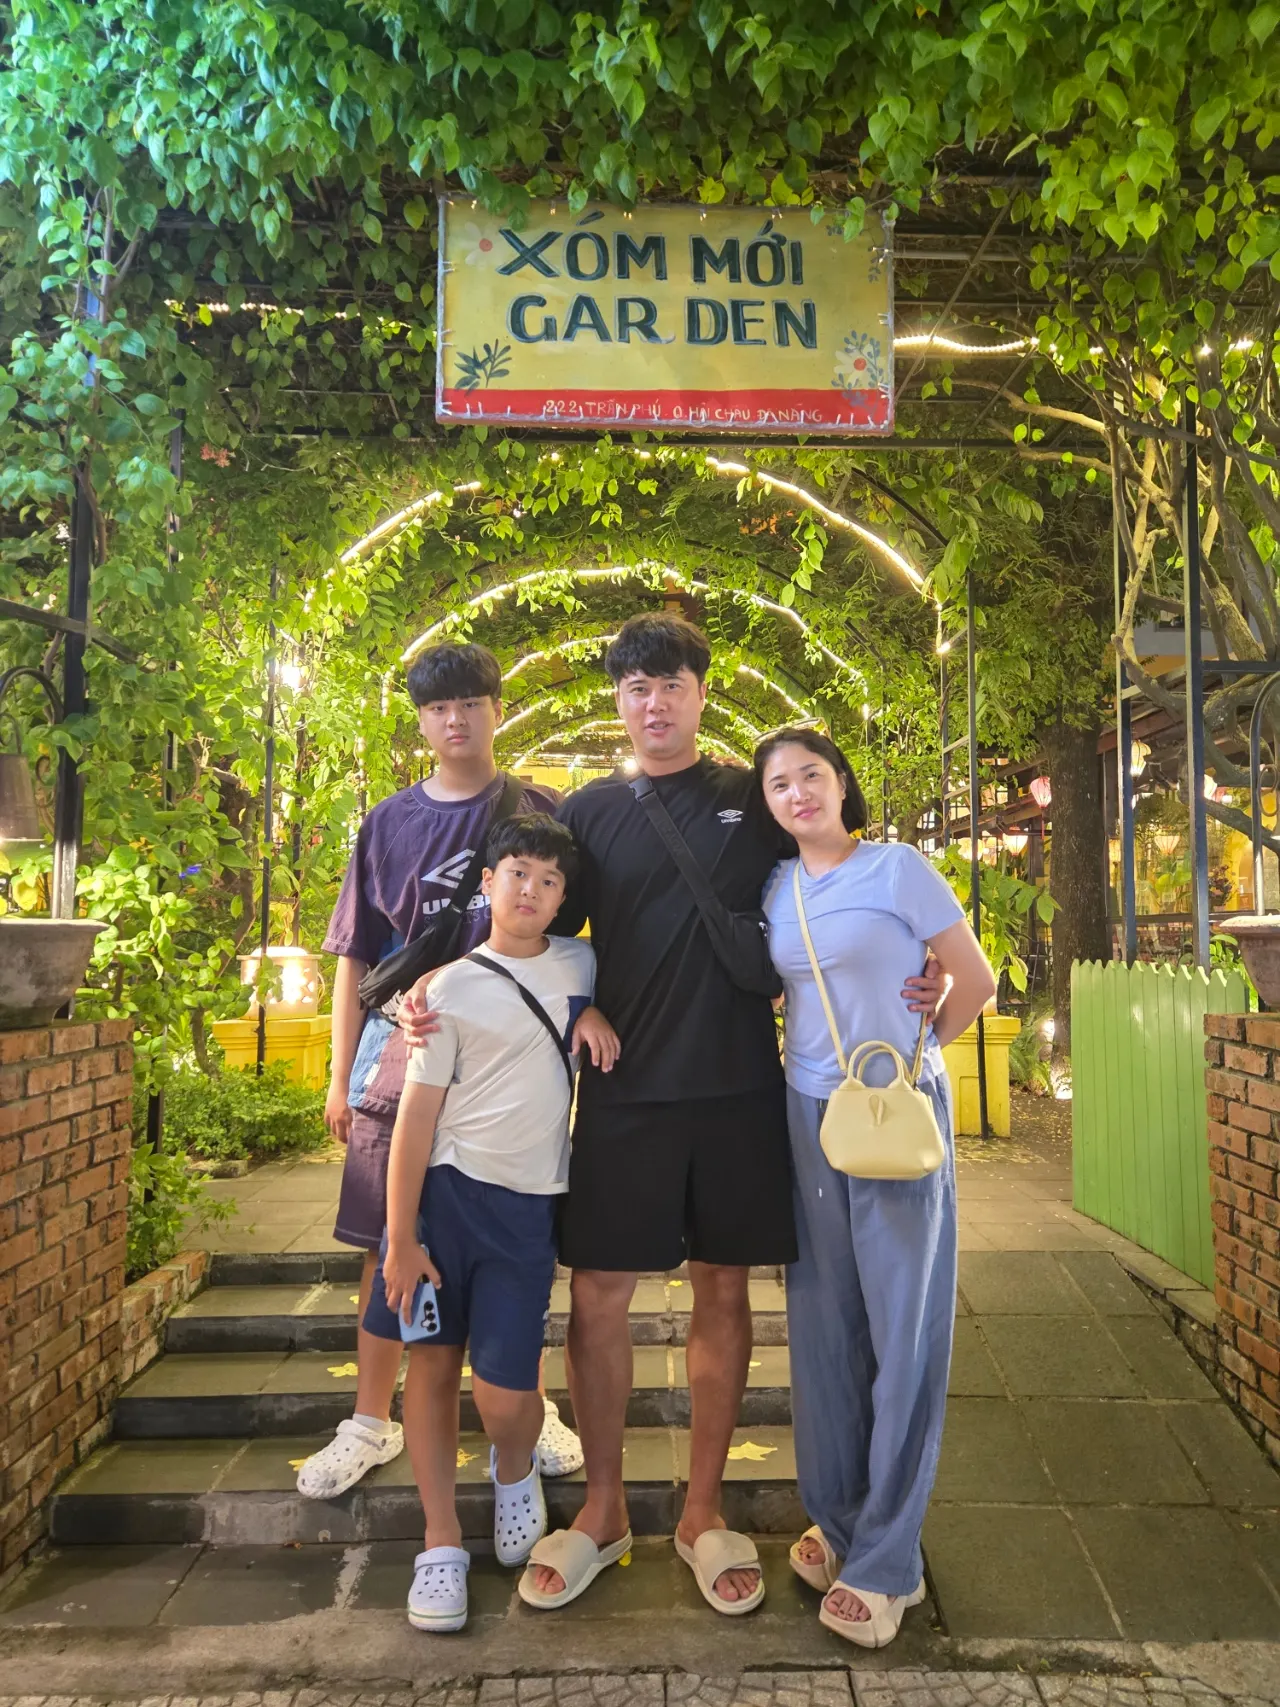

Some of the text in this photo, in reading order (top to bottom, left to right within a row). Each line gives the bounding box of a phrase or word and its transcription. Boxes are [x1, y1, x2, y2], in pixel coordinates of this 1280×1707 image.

[497, 210, 804, 287] XÓM MỚI
[546, 399, 577, 413] 222
